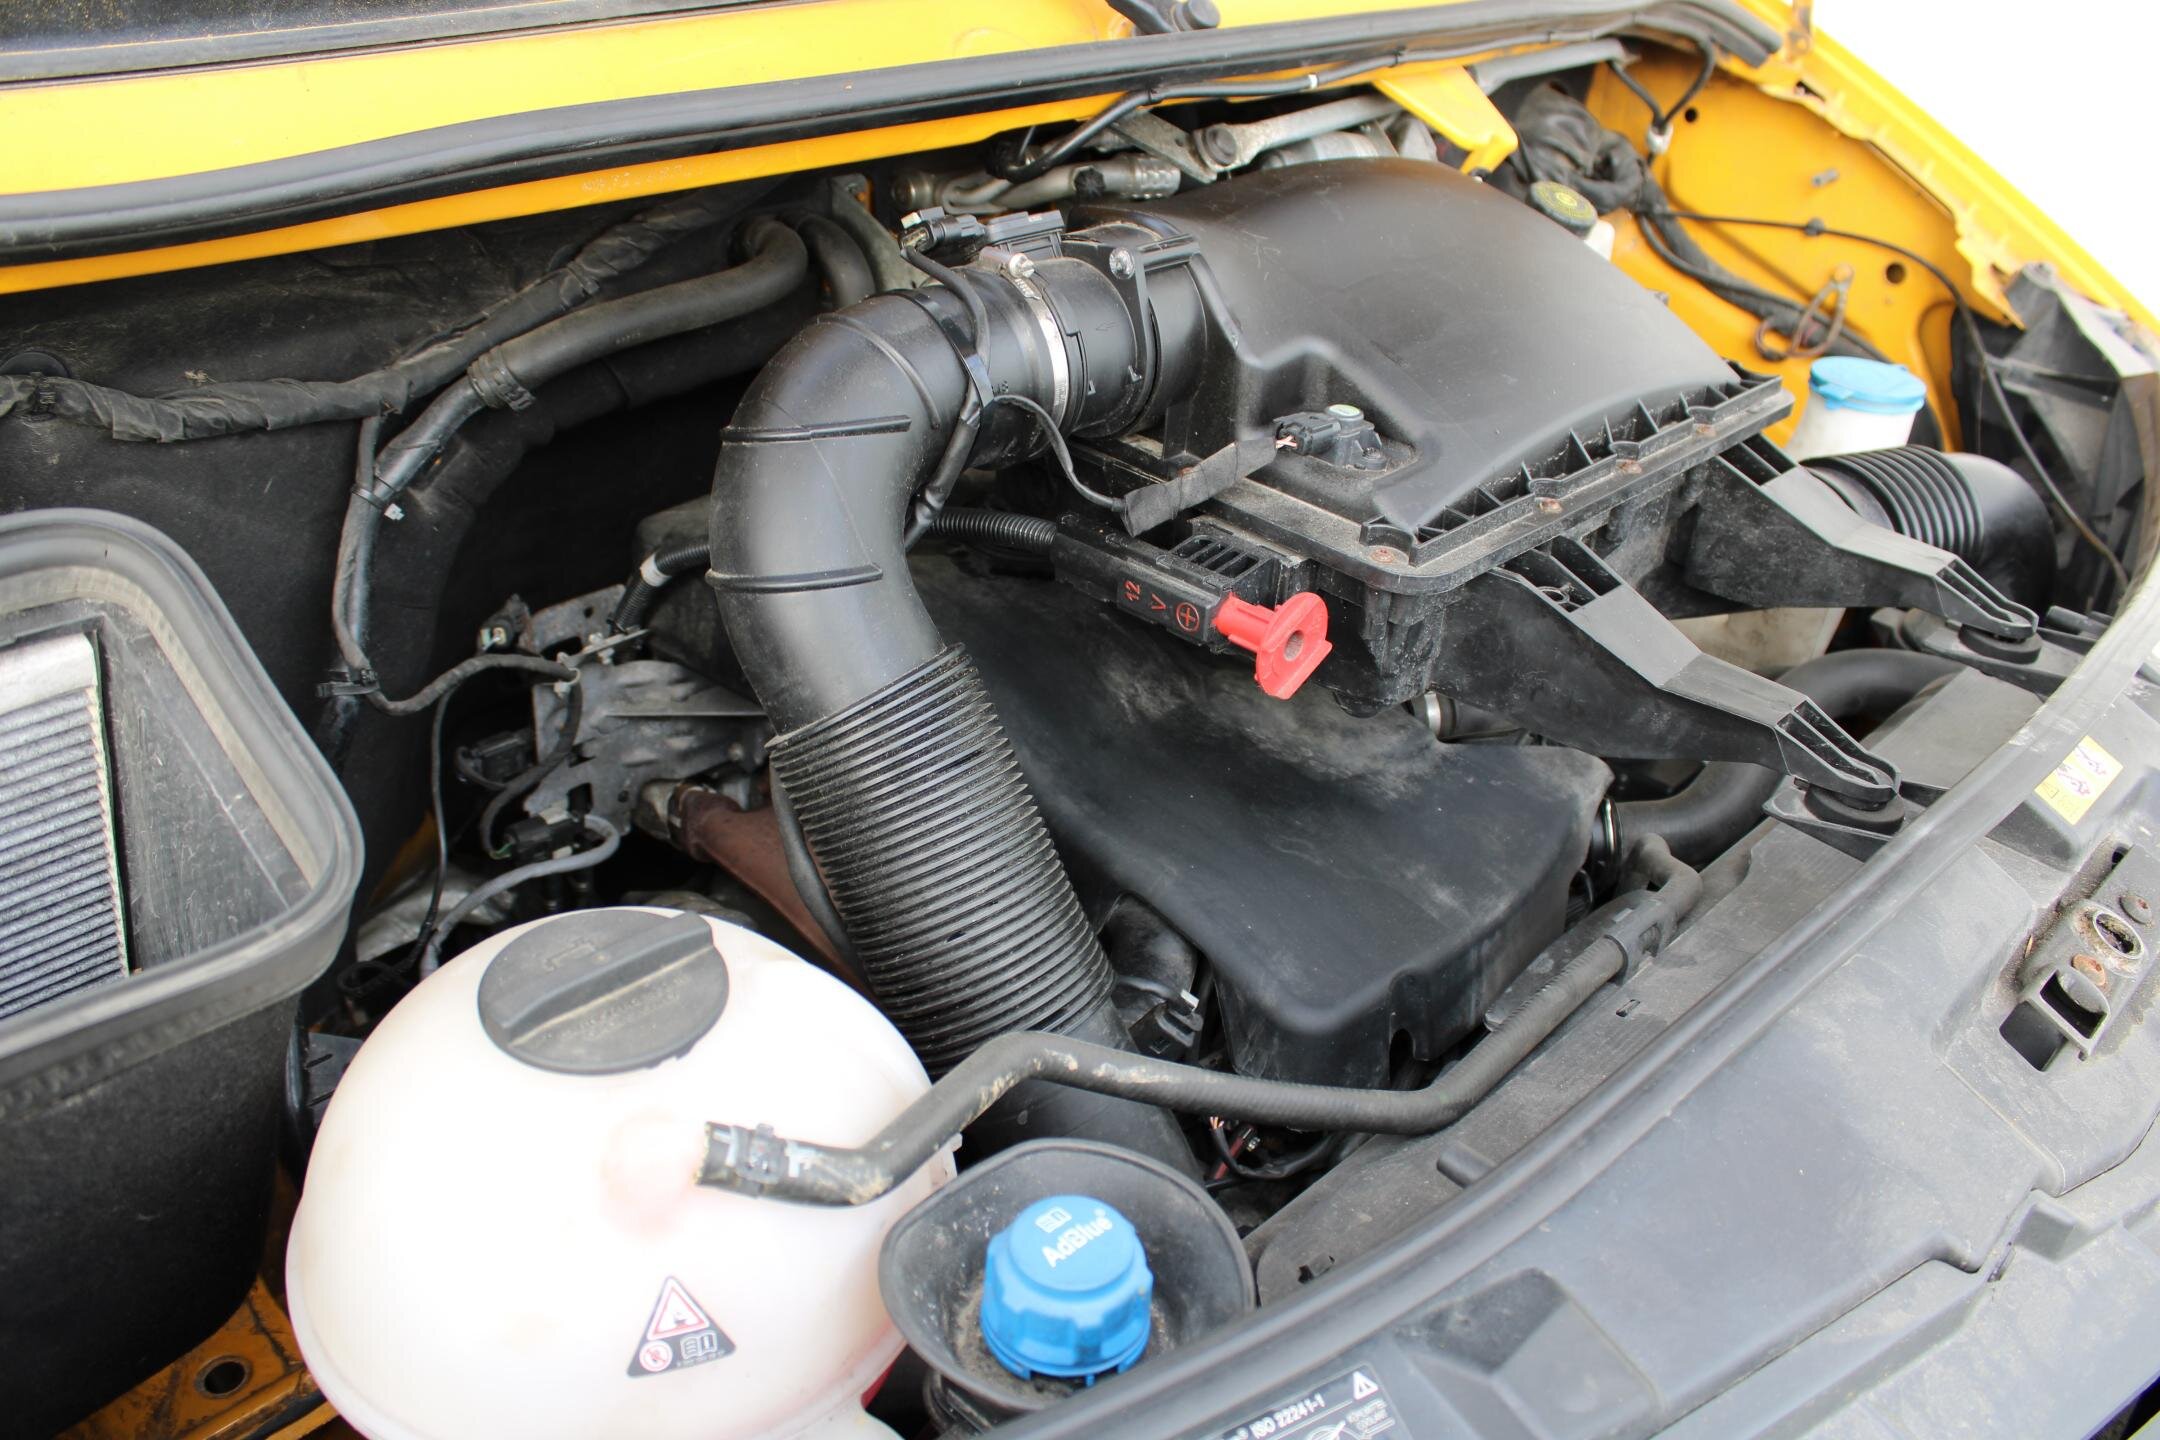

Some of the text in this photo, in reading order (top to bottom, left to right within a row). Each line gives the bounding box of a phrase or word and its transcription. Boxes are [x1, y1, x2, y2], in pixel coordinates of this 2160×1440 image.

[1125, 580, 1167, 610] 12 V
[1249, 1416, 1277, 1439] ISO
[1274, 1393, 1325, 1428] 22241-1
